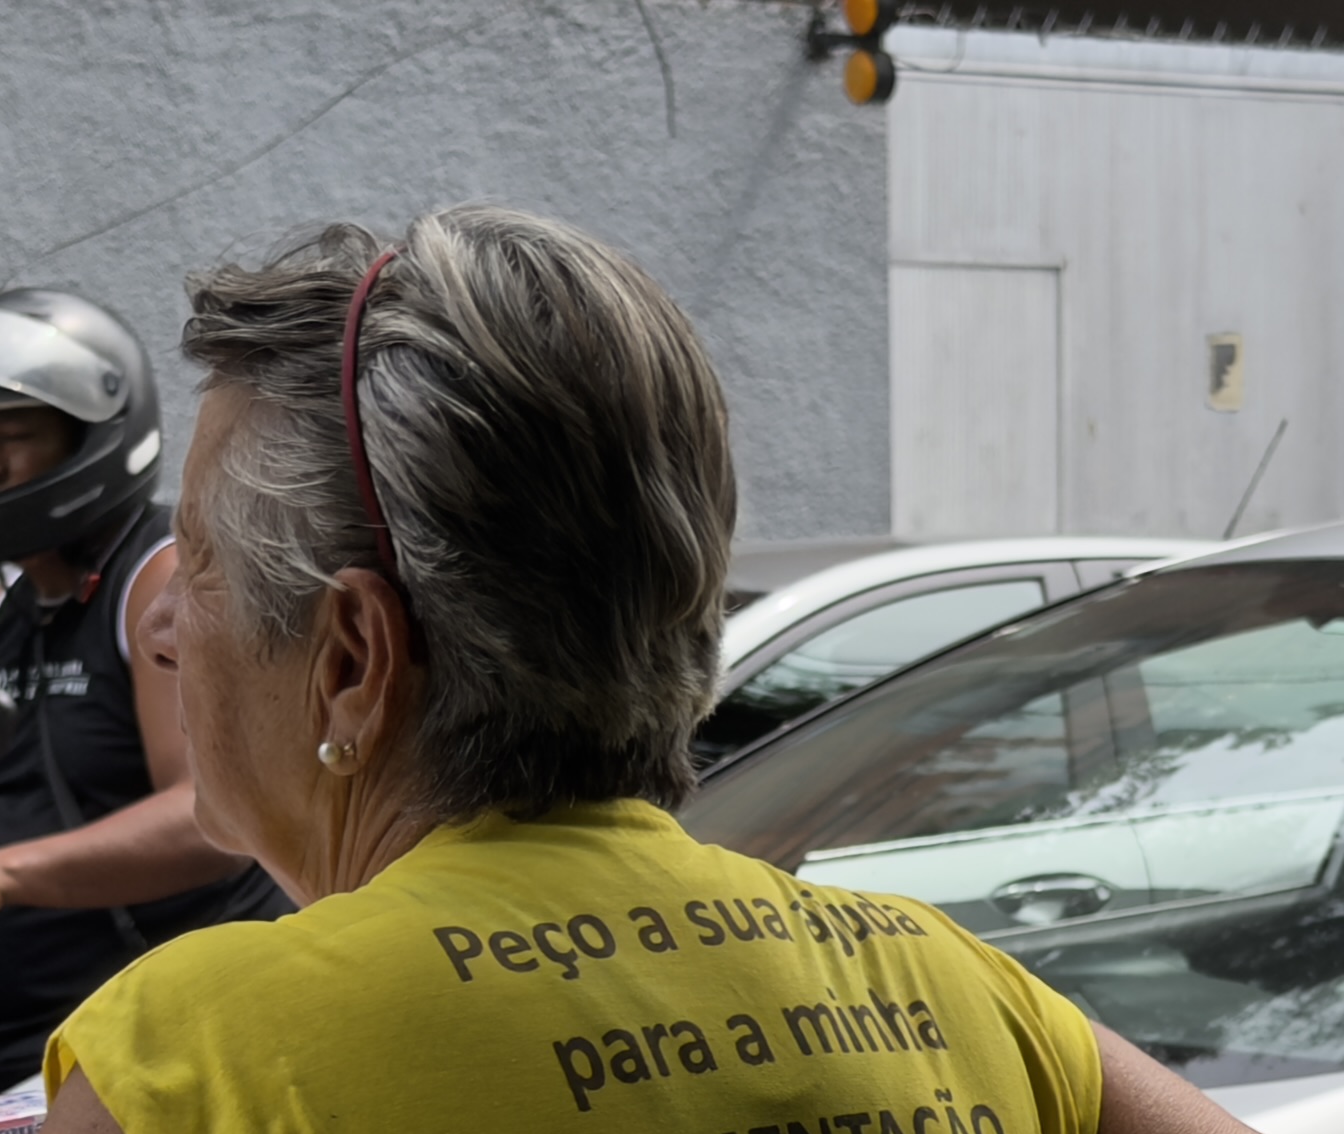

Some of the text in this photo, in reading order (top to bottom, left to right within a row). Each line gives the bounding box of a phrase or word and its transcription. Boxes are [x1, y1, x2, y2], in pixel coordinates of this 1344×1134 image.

[432, 889, 929, 982] Peço a sua ajuda
[552, 987, 949, 1112] para a minha
